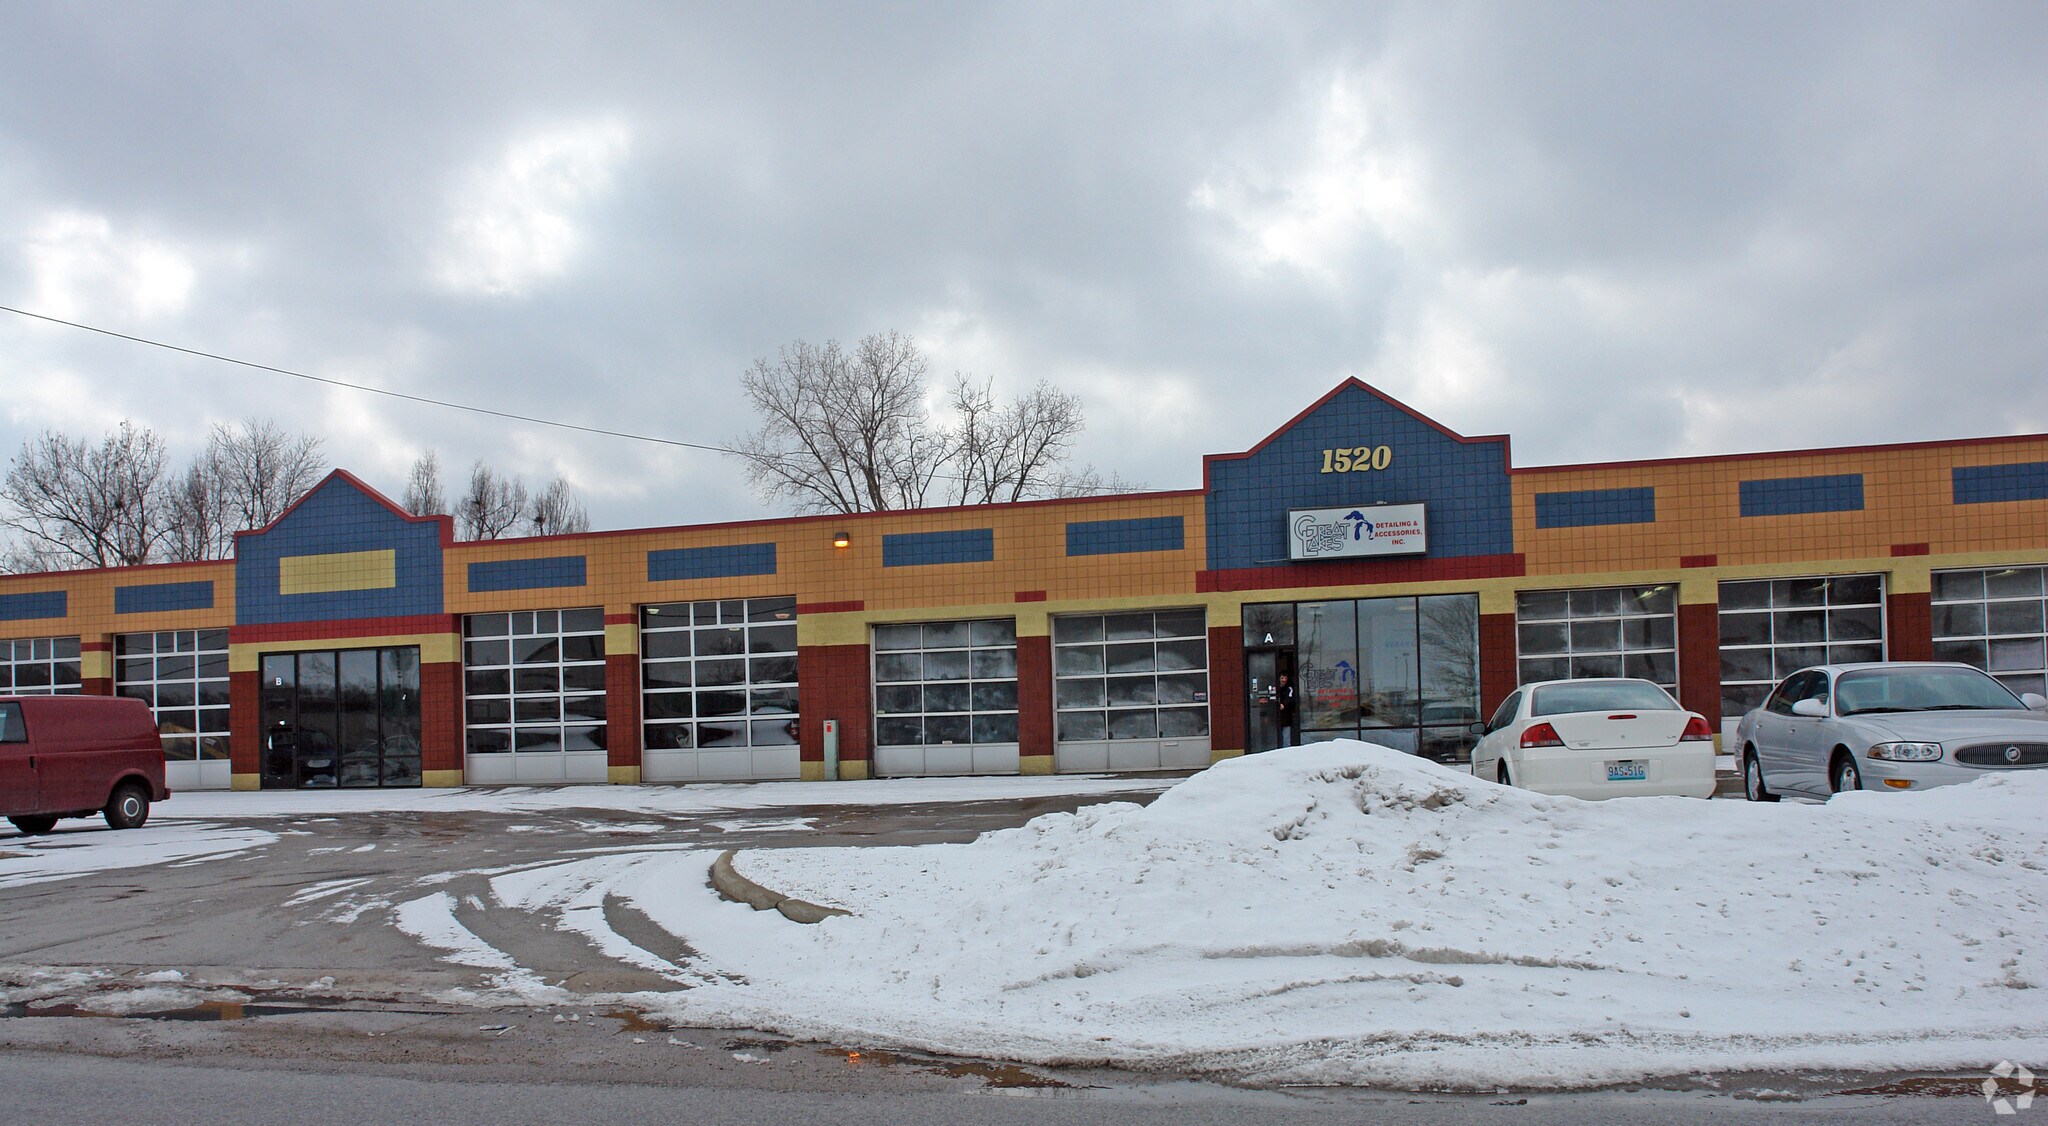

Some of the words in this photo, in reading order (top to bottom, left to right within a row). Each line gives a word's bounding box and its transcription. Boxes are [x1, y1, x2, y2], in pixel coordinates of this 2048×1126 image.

[1320, 445, 1392, 474] 1520
[1294, 514, 1350, 541] GREAT
[1375, 521, 1411, 529] DETAILING
[1374, 529, 1423, 538] ACCESSORIES,
[1302, 536, 1345, 557] LAKES
[1264, 633, 1274, 643] A
[275, 677, 282, 686] B
